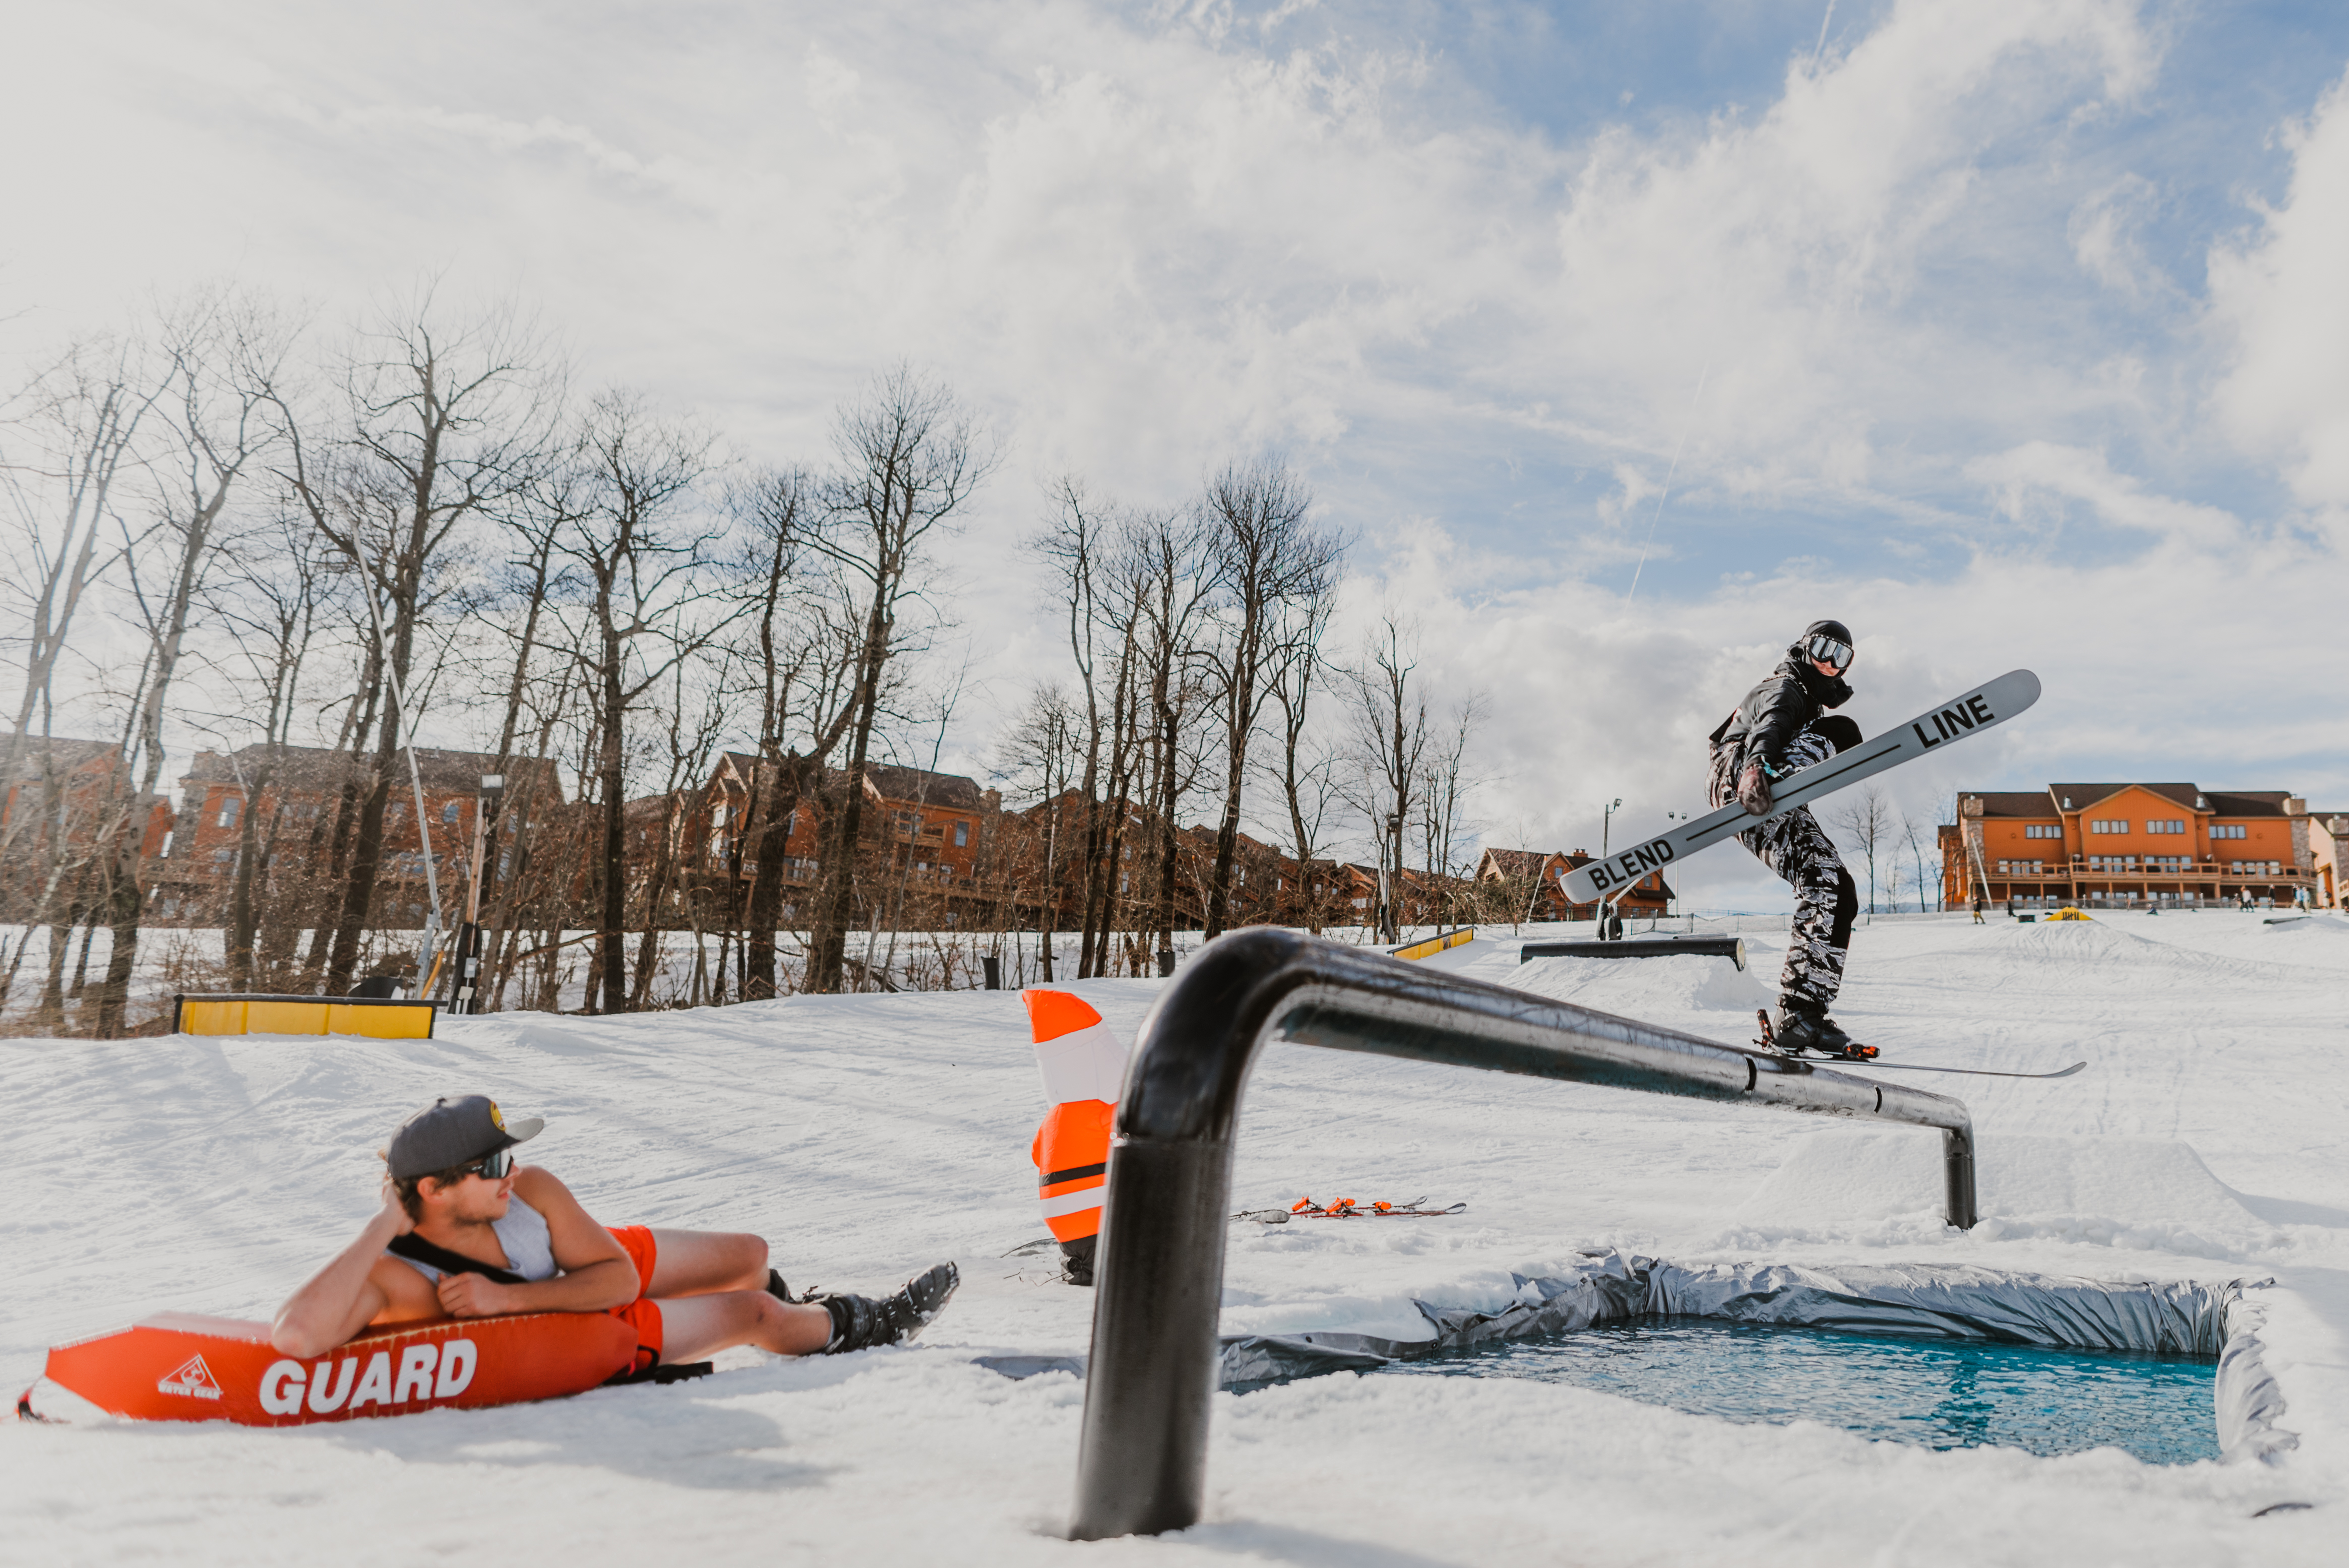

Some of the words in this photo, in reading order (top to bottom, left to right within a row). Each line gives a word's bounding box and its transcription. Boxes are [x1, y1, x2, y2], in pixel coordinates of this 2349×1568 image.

[1912, 694, 1995, 749] LINE
[1587, 839, 1674, 892] BLEND
[158, 1383, 192, 1396] WATER
[193, 1388, 220, 1400] GEAR
[259, 1338, 478, 1415] GUARD
